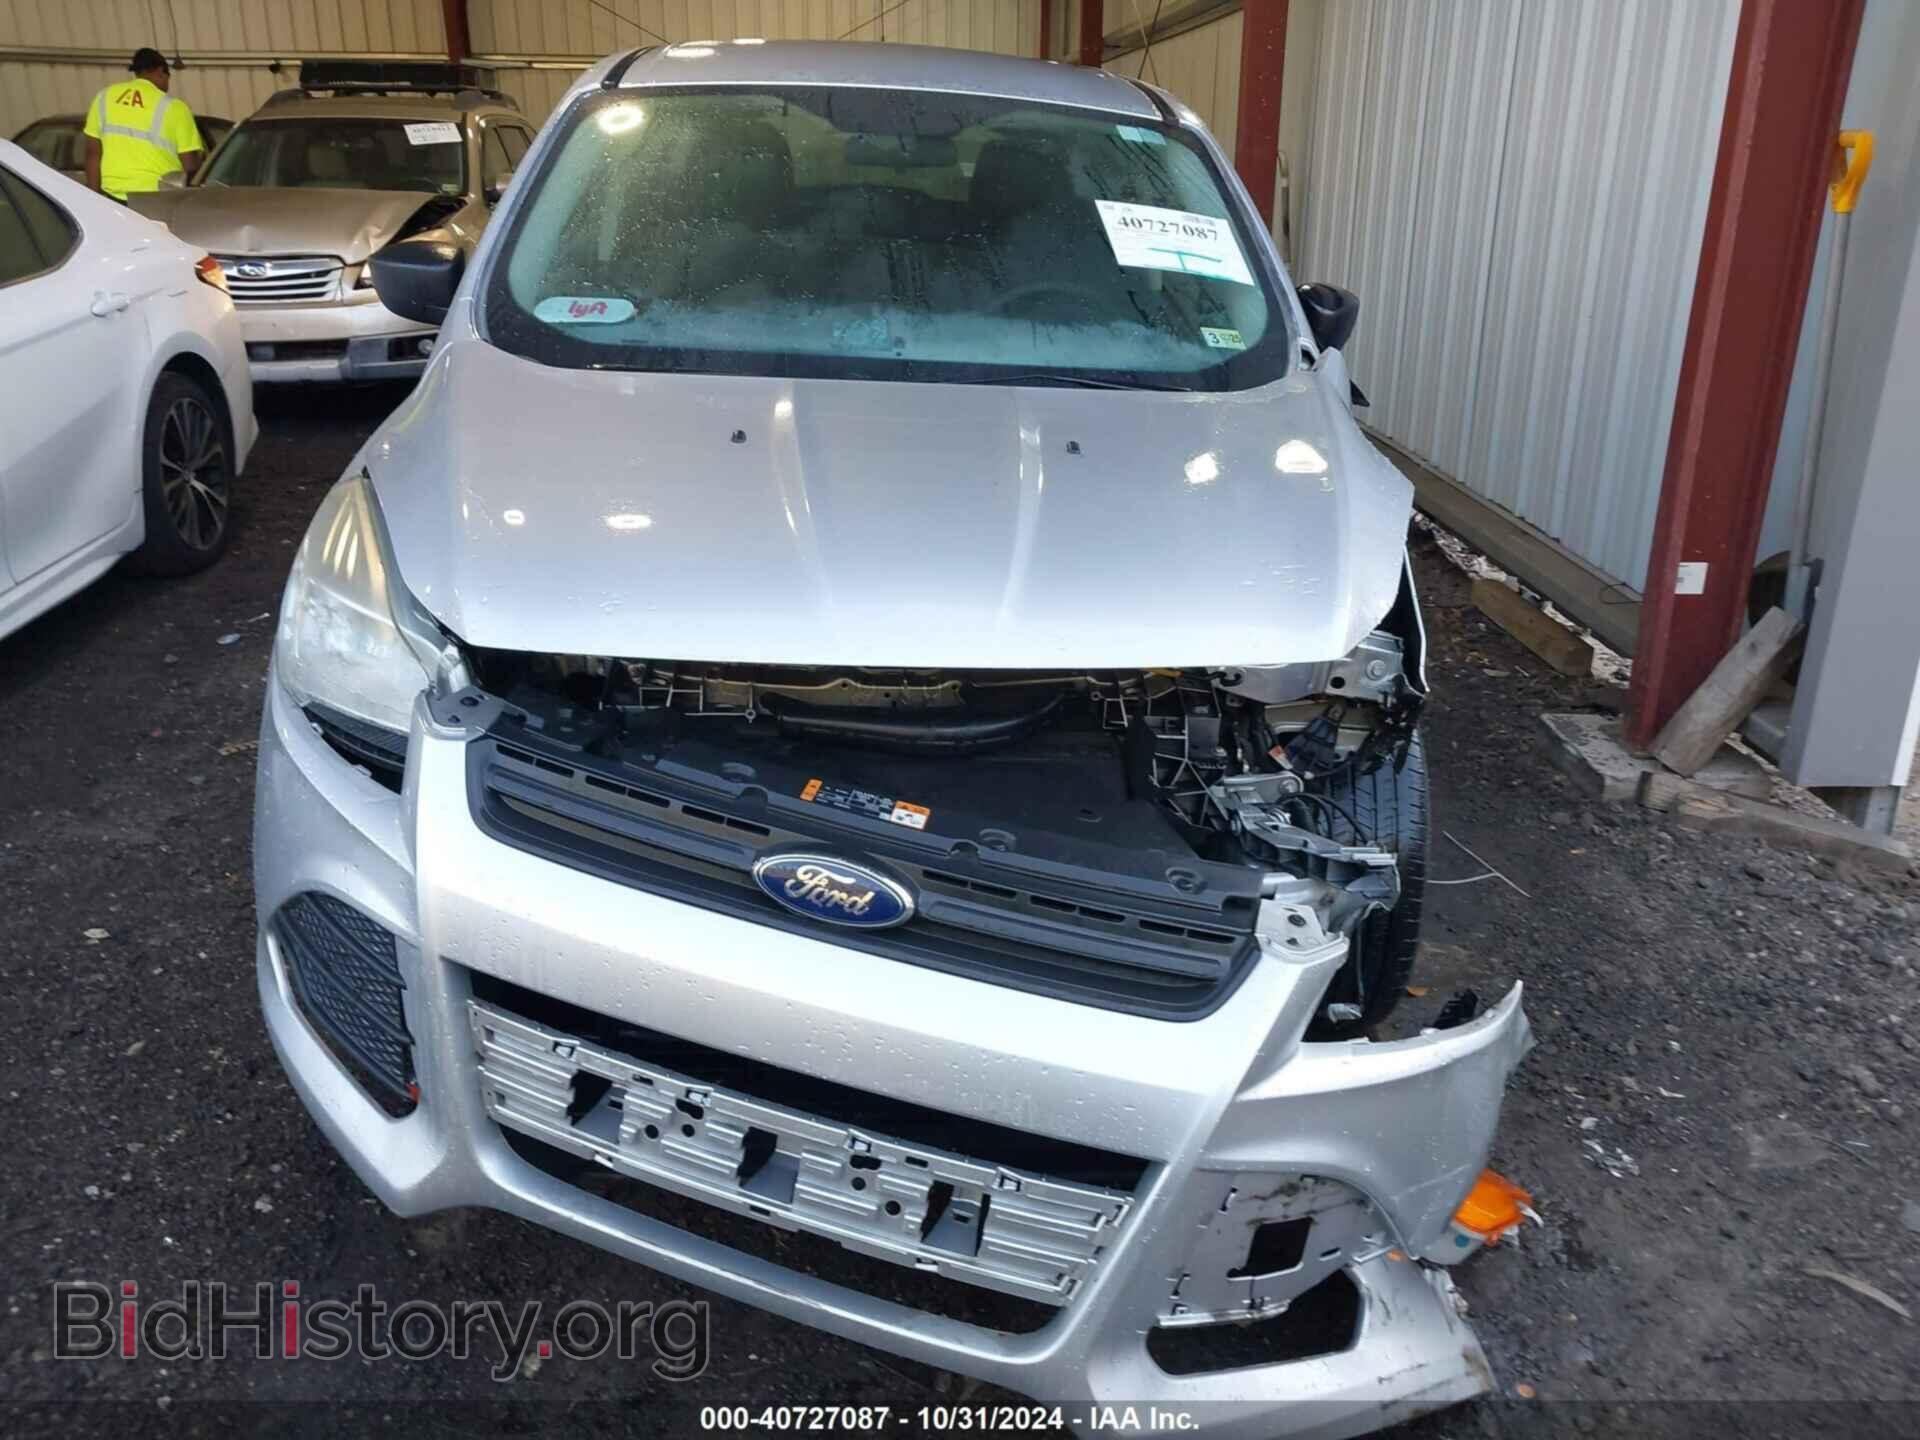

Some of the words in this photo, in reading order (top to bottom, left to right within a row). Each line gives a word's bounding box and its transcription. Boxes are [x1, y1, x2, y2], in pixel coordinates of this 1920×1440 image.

[1117, 215, 1218, 241] 40727087
[567, 300, 608, 319] lyft
[1208, 332, 1220, 344] 3
[784, 865, 876, 916] Ford
